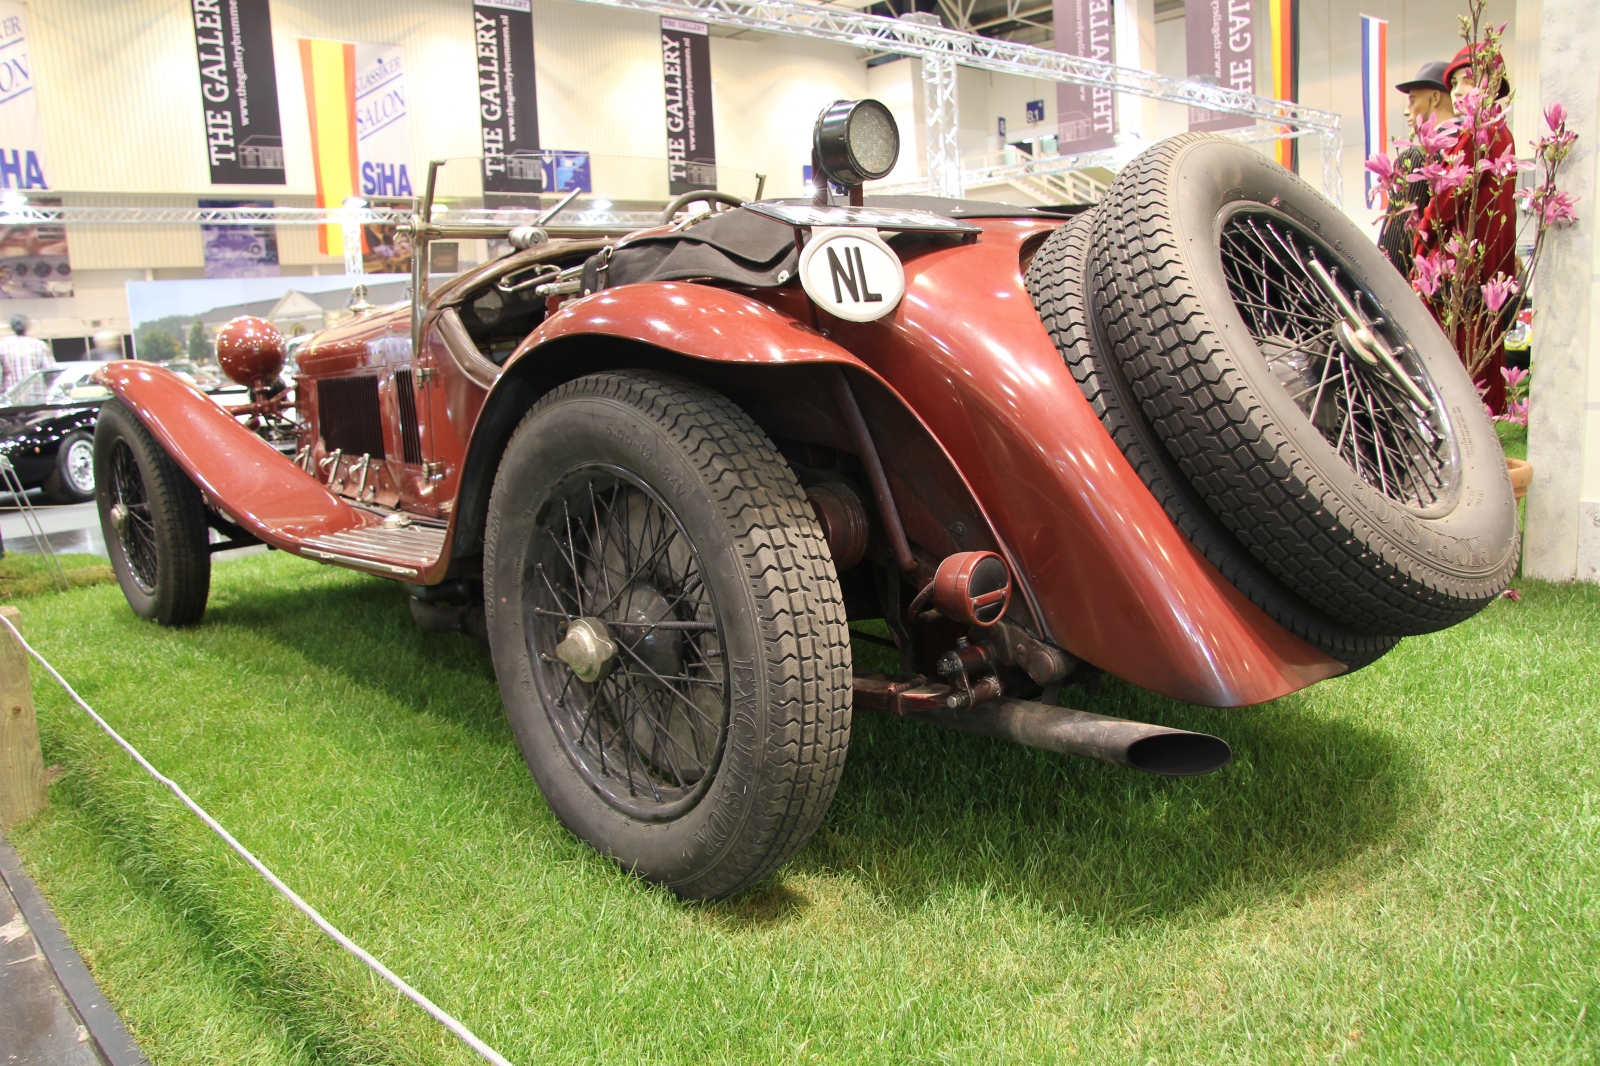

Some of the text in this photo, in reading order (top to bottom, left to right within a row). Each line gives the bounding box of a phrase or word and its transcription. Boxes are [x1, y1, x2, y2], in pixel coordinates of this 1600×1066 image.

[194, 0, 236, 166] THE GALLER
[356, 86, 406, 133] SALON
[475, 11, 502, 122] GALLERY
[499, 15, 516, 142] www.thegallerybrummen.nl
[662, 34, 687, 182] THE GALLERY
[682, 37, 697, 151] www.thegallerybrummen.nl
[362, 161, 413, 196] SiHA
[483, 127, 505, 176] THE
[826, 246, 882, 303] NL
[1350, 482, 1491, 567] EXCELSIOR
[693, 656, 758, 856] EXCELSIOR
